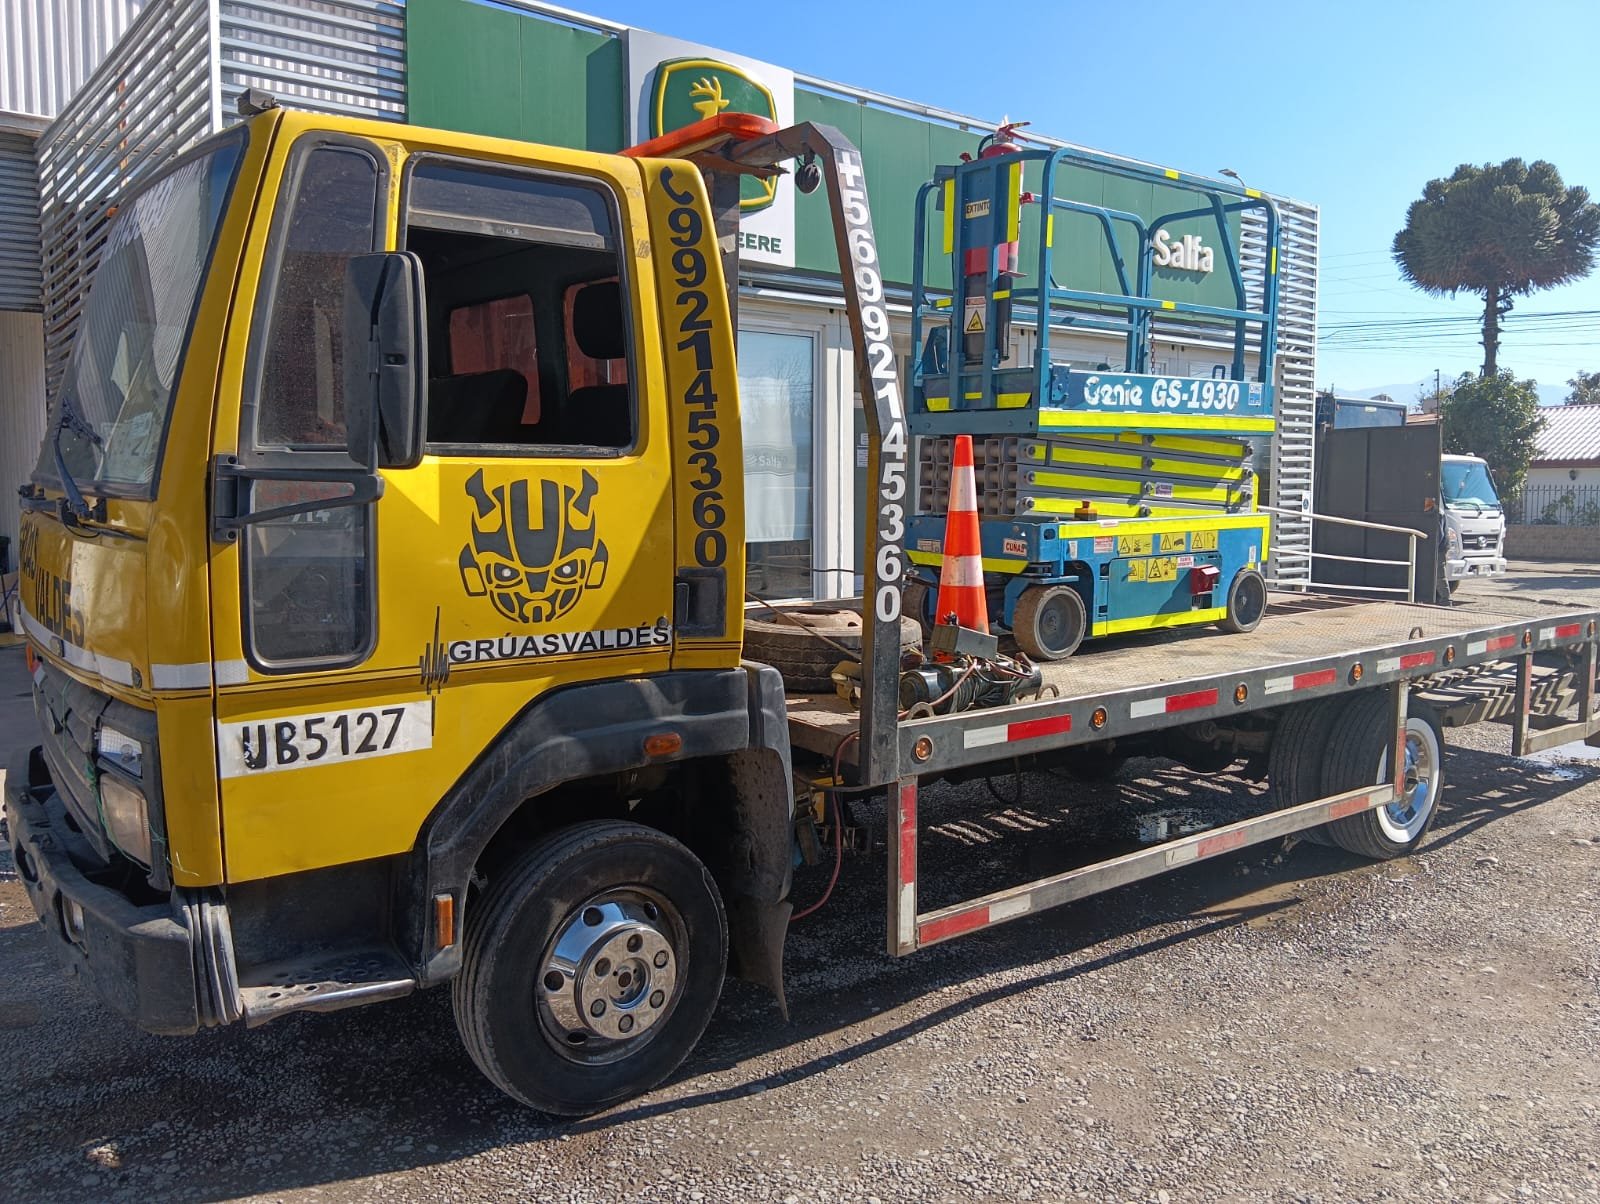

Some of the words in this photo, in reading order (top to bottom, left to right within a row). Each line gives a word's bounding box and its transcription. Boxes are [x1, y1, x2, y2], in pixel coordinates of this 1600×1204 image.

[1153, 229, 1214, 273] Salfa
[668, 208, 727, 568] 992145360
[1083, 375, 1144, 406] Genie
[1151, 378, 1240, 410] GS-1930
[242, 707, 406, 769] UB5127
